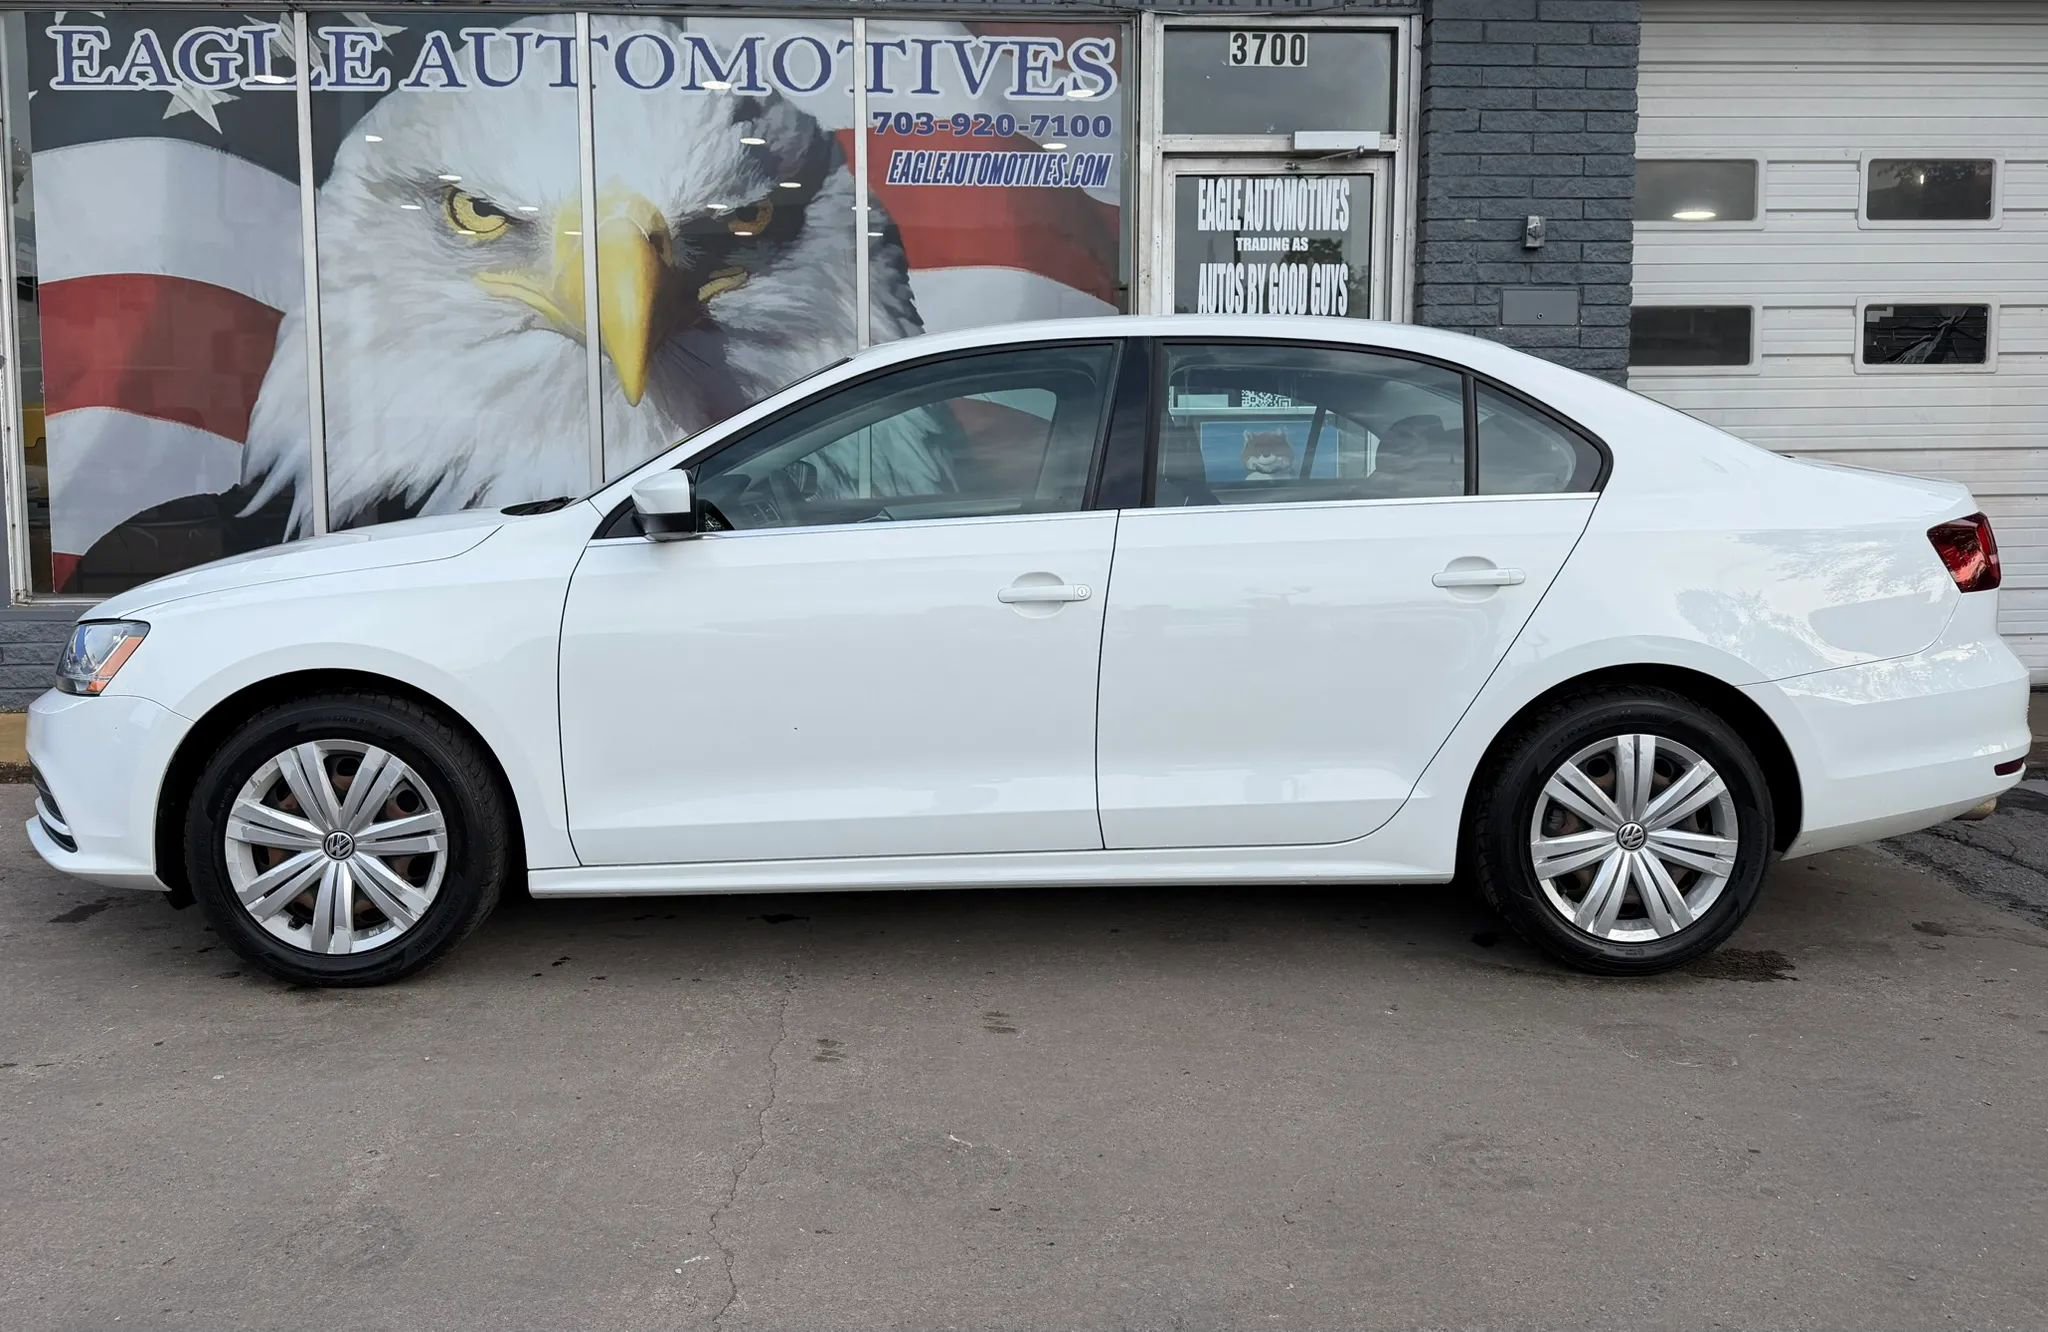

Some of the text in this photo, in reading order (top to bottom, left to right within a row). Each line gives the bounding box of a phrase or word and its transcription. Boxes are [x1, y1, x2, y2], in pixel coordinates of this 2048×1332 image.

[46, 24, 1117, 101] EAGLE AUTOMOTIVES
[1231, 32, 1306, 66] 3700
[871, 110, 1113, 138] 703-920-7100
[885, 149, 1114, 188] EAGLEAUTOMOTIVES.COM
[1198, 178, 1350, 232] EAGLE AUTOMOTIVES
[1235, 237, 1309, 251] TRADING AS
[1197, 262, 1349, 316] AUTOS BY GOOD GUYS
